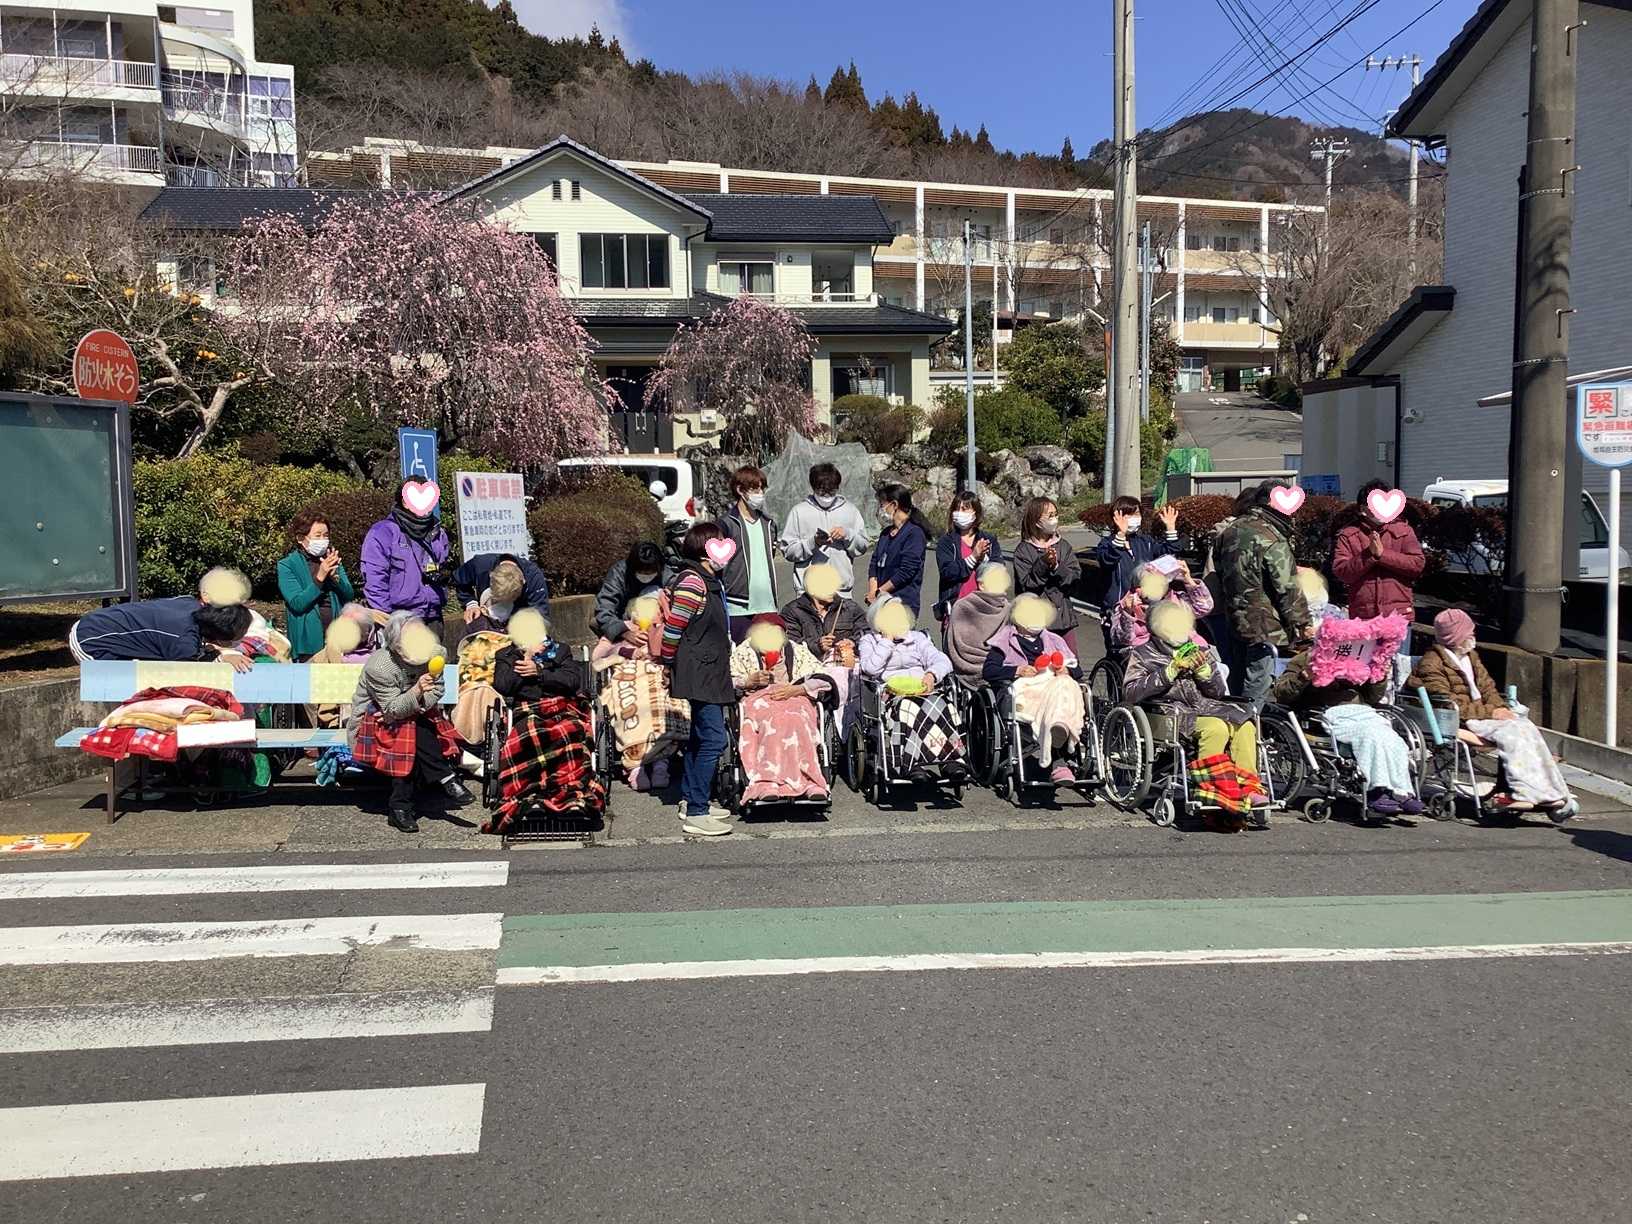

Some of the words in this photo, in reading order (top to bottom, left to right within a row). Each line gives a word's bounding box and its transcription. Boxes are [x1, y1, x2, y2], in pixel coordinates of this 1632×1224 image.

[85, 342, 100, 352] FIRE
[79, 355, 135, 393] 防火水そう
[1589, 392, 1613, 414] 緊
